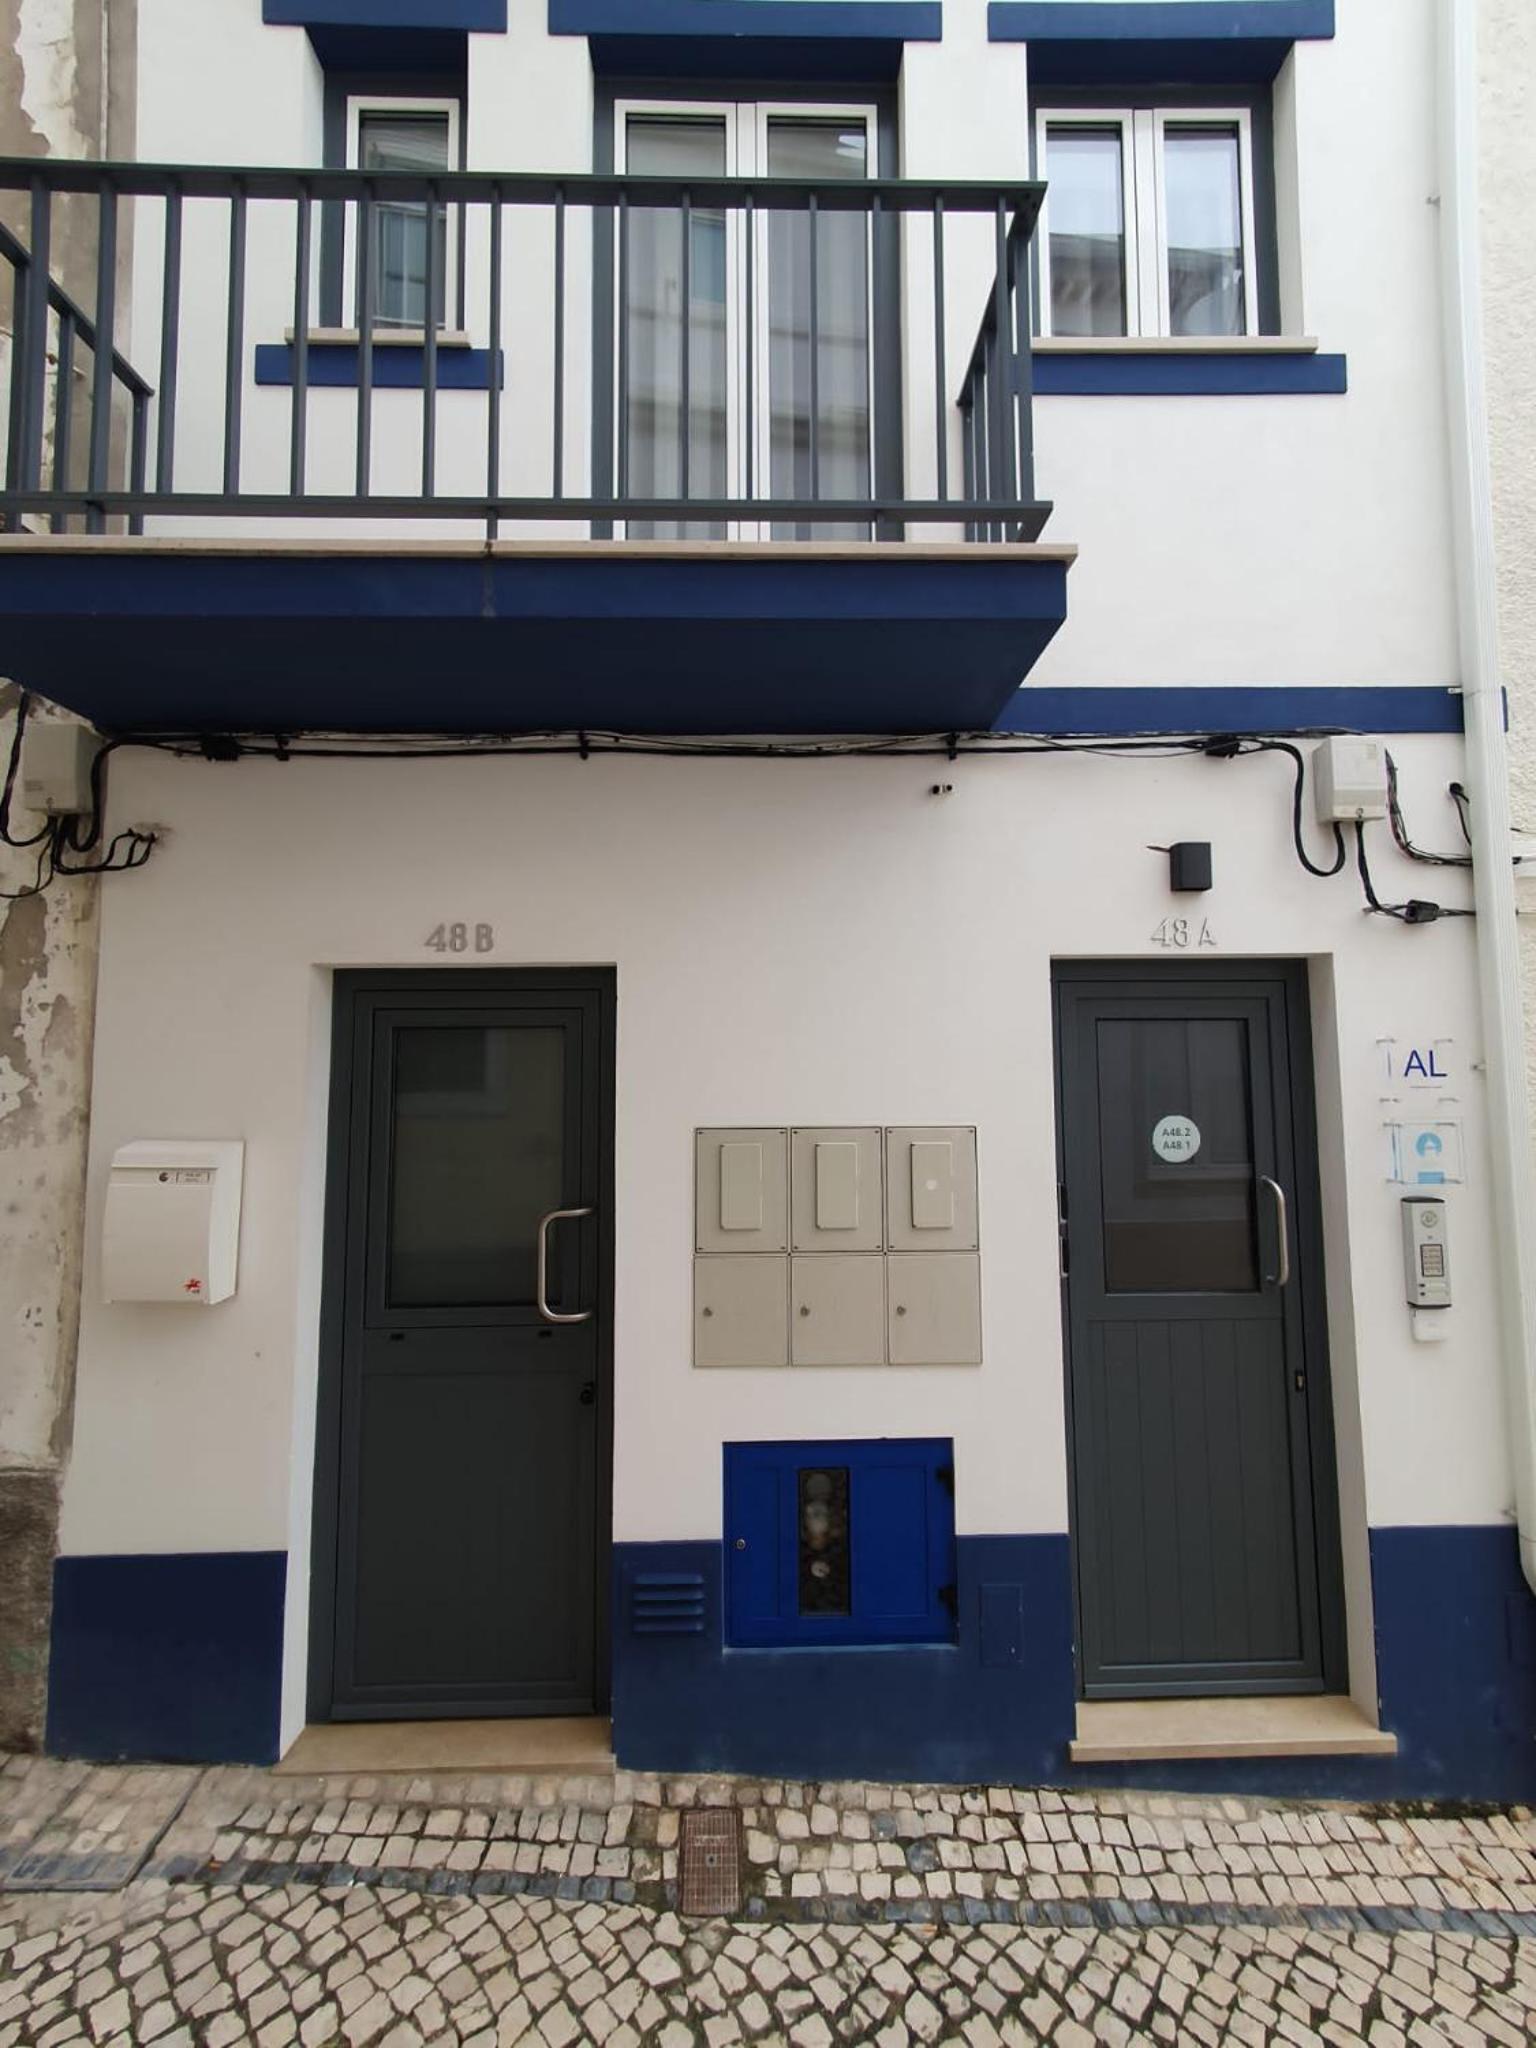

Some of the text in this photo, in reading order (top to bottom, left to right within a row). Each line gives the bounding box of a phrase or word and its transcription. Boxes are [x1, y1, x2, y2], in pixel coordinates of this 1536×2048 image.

[424, 923, 468, 952] 48
[1150, 917, 1188, 948] 48
[1404, 1049, 1448, 1077] AL
